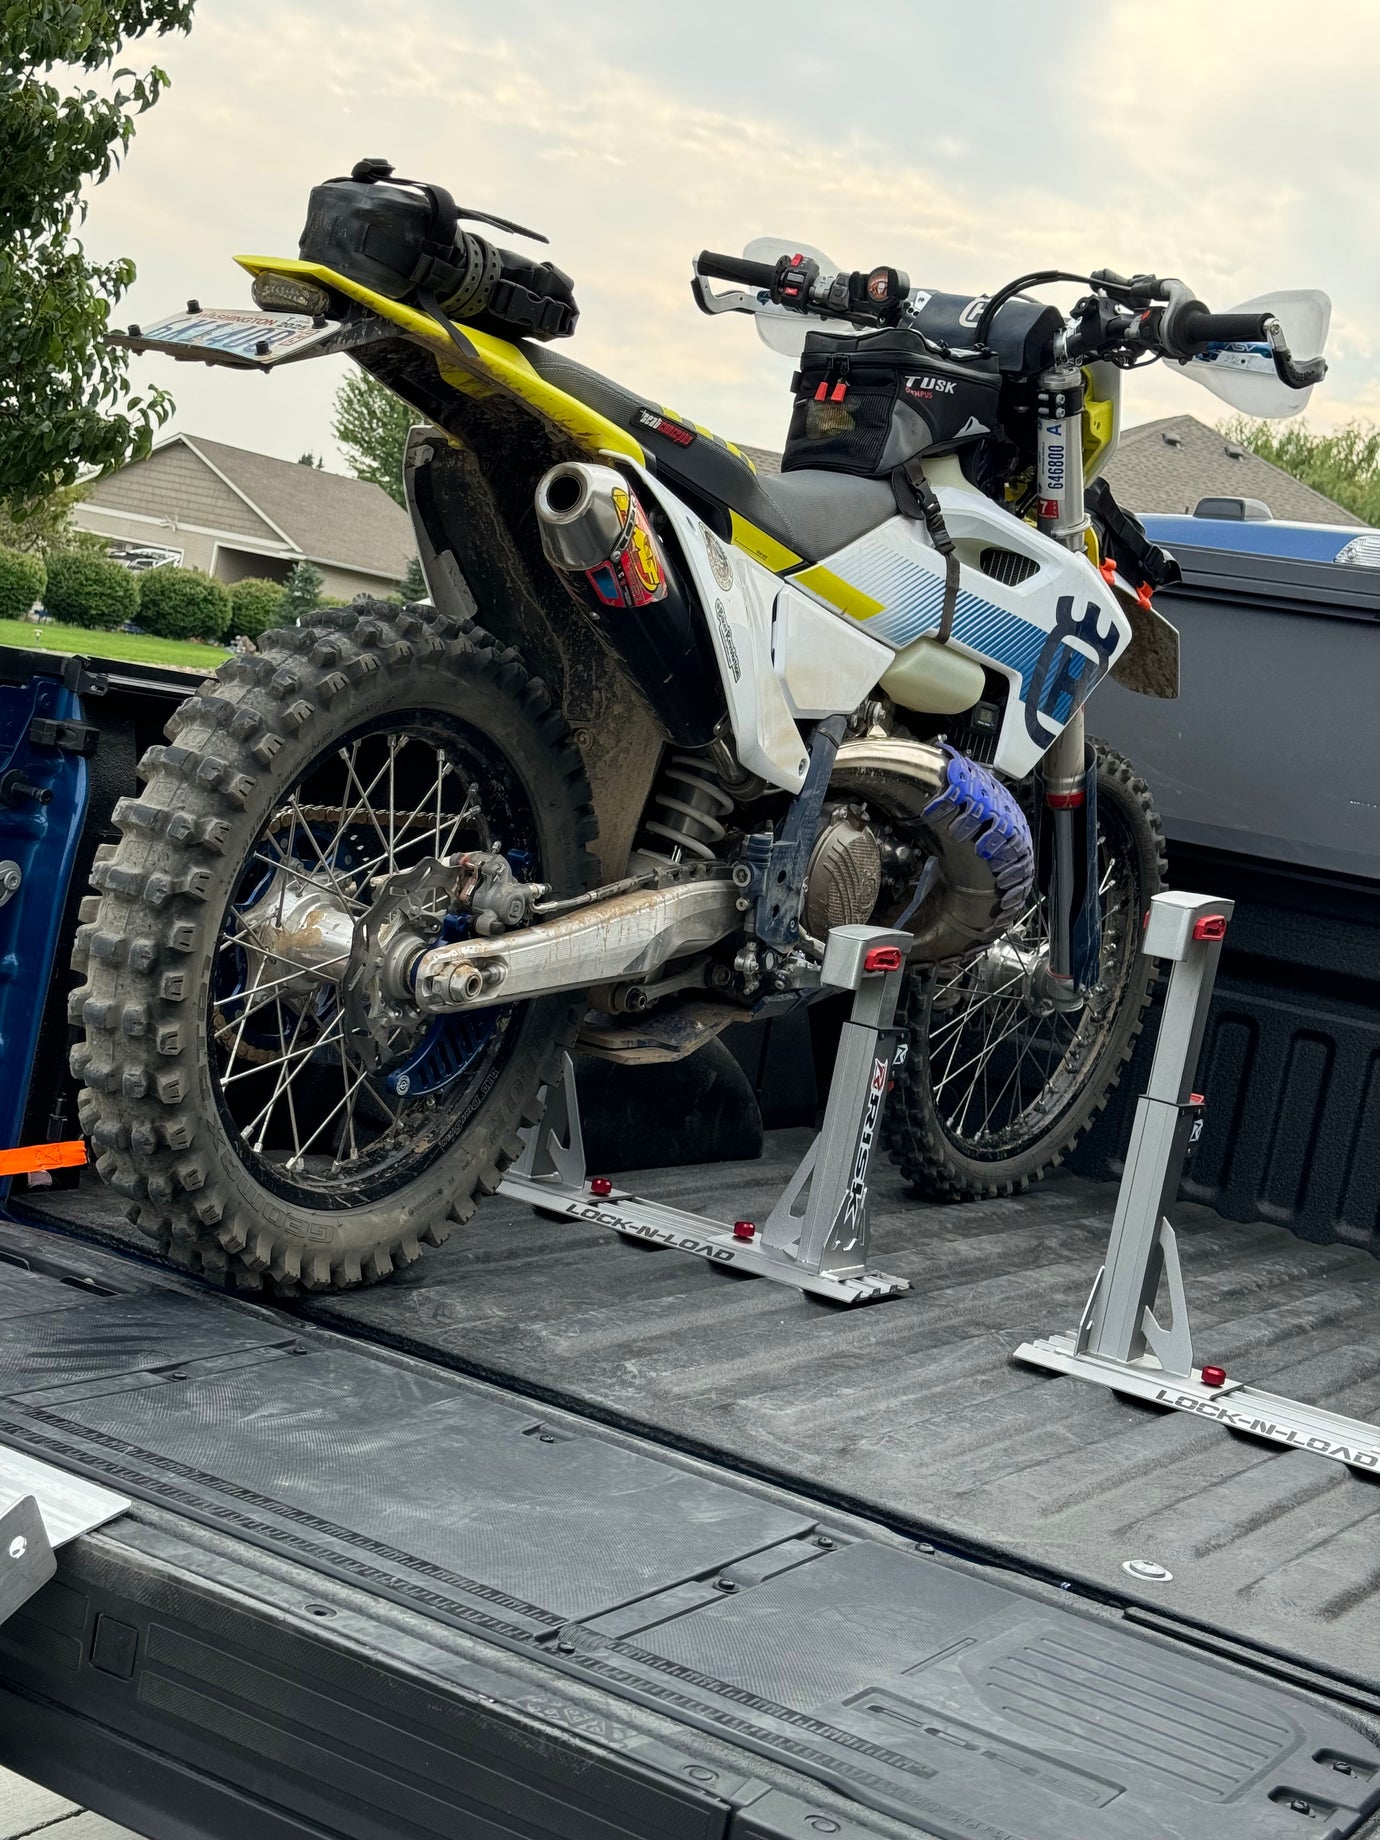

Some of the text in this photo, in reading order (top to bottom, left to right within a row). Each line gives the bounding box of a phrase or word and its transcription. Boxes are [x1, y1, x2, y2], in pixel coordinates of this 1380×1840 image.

[199, 311, 276, 326] WASHINGTON
[904, 375, 958, 394] TUSK
[1046, 424, 1064, 490] 646800 A
[565, 1203, 736, 1262] LOCK-N-LOAD
[1155, 1389, 1379, 1468] LOCK-N-LOAD
